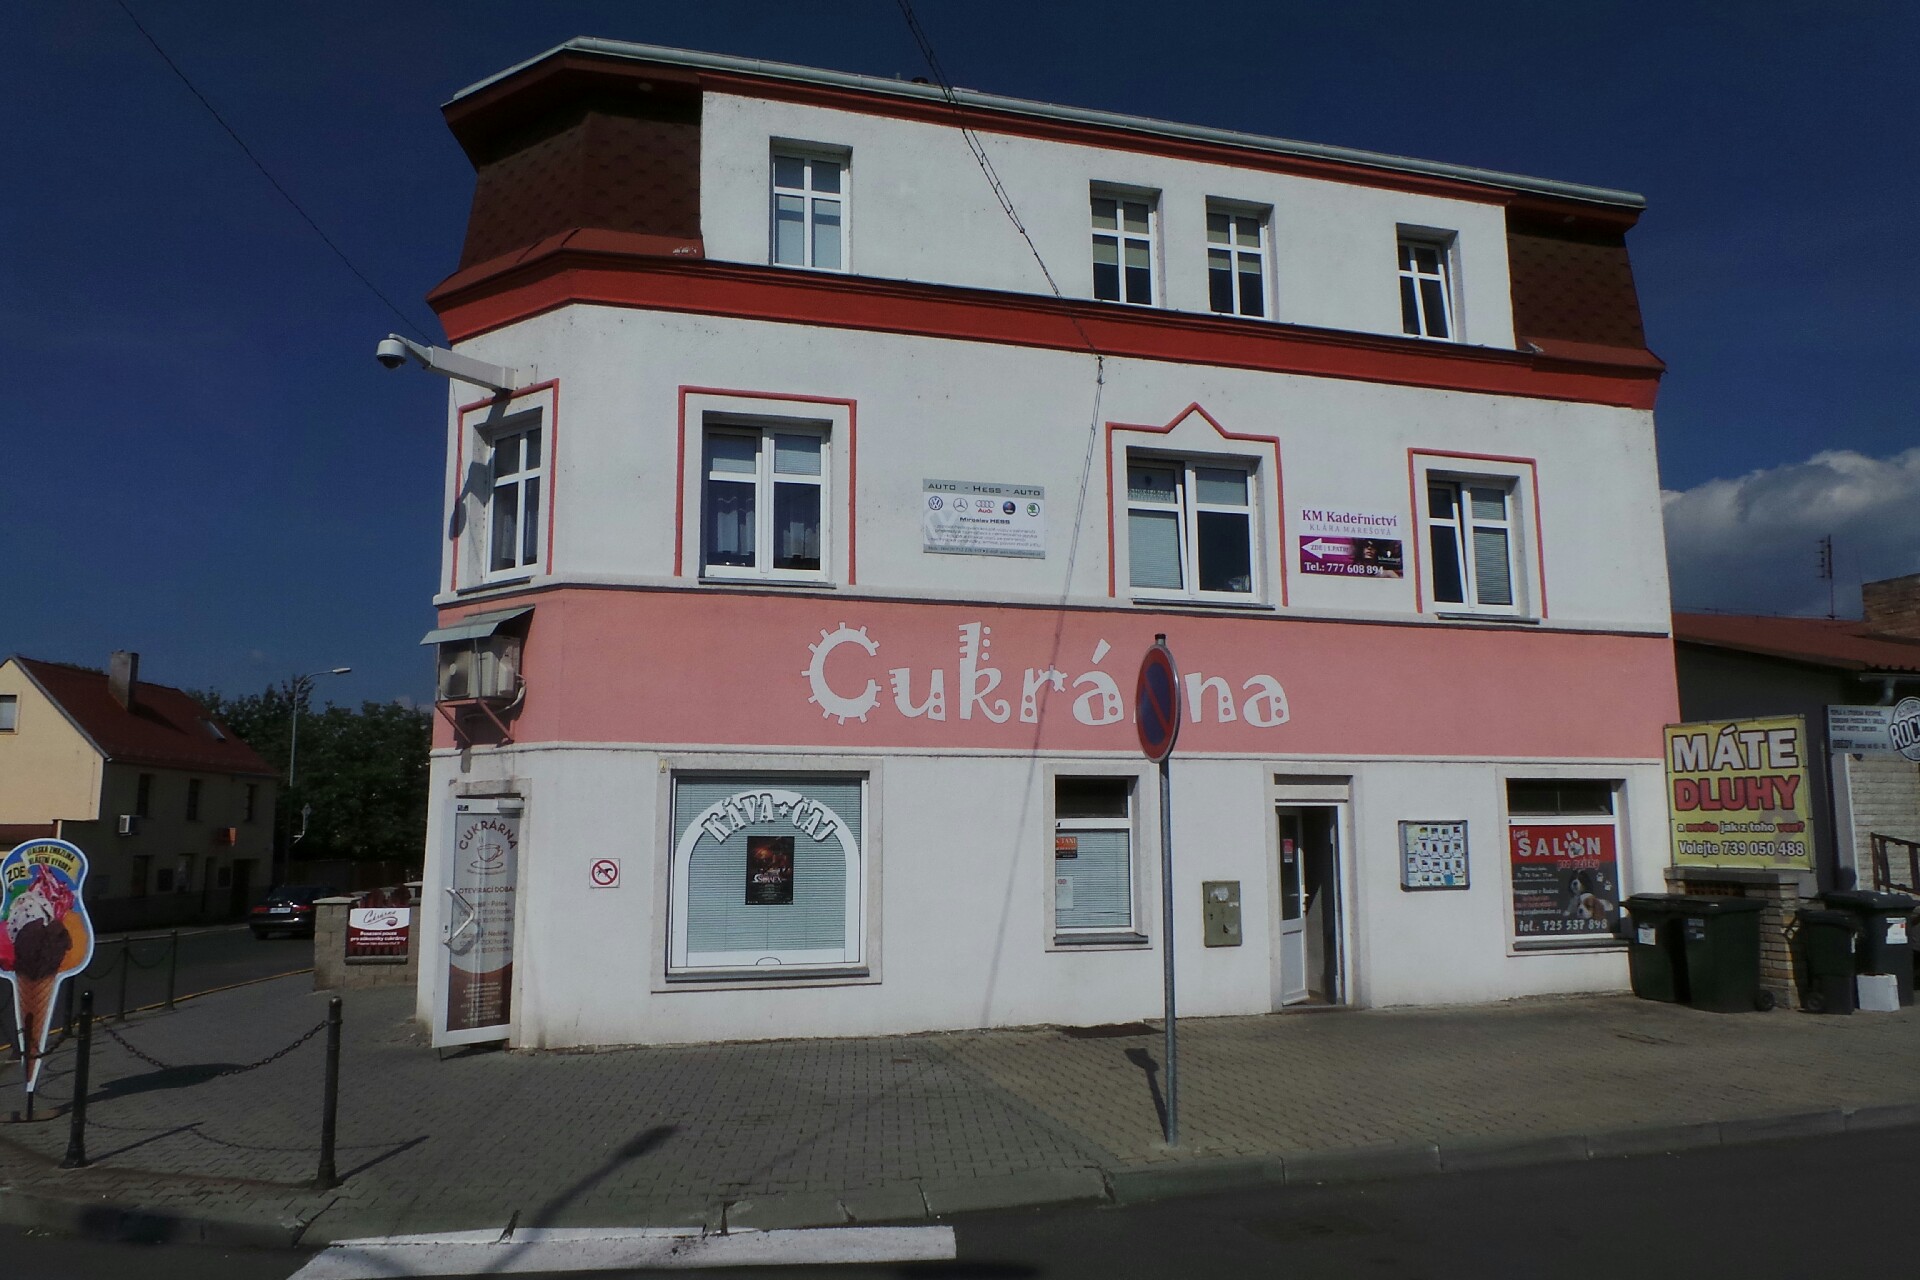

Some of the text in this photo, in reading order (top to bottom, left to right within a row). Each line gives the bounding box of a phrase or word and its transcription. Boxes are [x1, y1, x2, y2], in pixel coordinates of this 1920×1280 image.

[928, 483, 956, 491] AUTO
[973, 485, 1002, 493] HESS
[1302, 509, 1397, 527] KM Kadeřnictví
[1309, 524, 1392, 536] KLÁRA MAREŠOVÁ
[1304, 562, 1384, 575] Tel.: 777 608 894
[801, 621, 1290, 728] Cukrána
[1889, 714, 1920, 751] ROC
[1671, 723, 1799, 773] MÁTE
[1673, 775, 1801, 811] DLUHY
[701, 792, 839, 845] KÁVA ČAJ
[459, 817, 518, 850] CUKRÁRNA
[1677, 823, 1685, 833] a
[1720, 821, 1739, 835] jak
[1740, 823, 1748, 833] z
[1750, 821, 1775, 833] toho
[1678, 840, 1806, 857] Volejte 739 050 488
[6, 865, 26, 883] ZDE
[1542, 920, 1563, 931] 725
[1566, 919, 1585, 930] 537
[1588, 918, 1608, 929] 898
